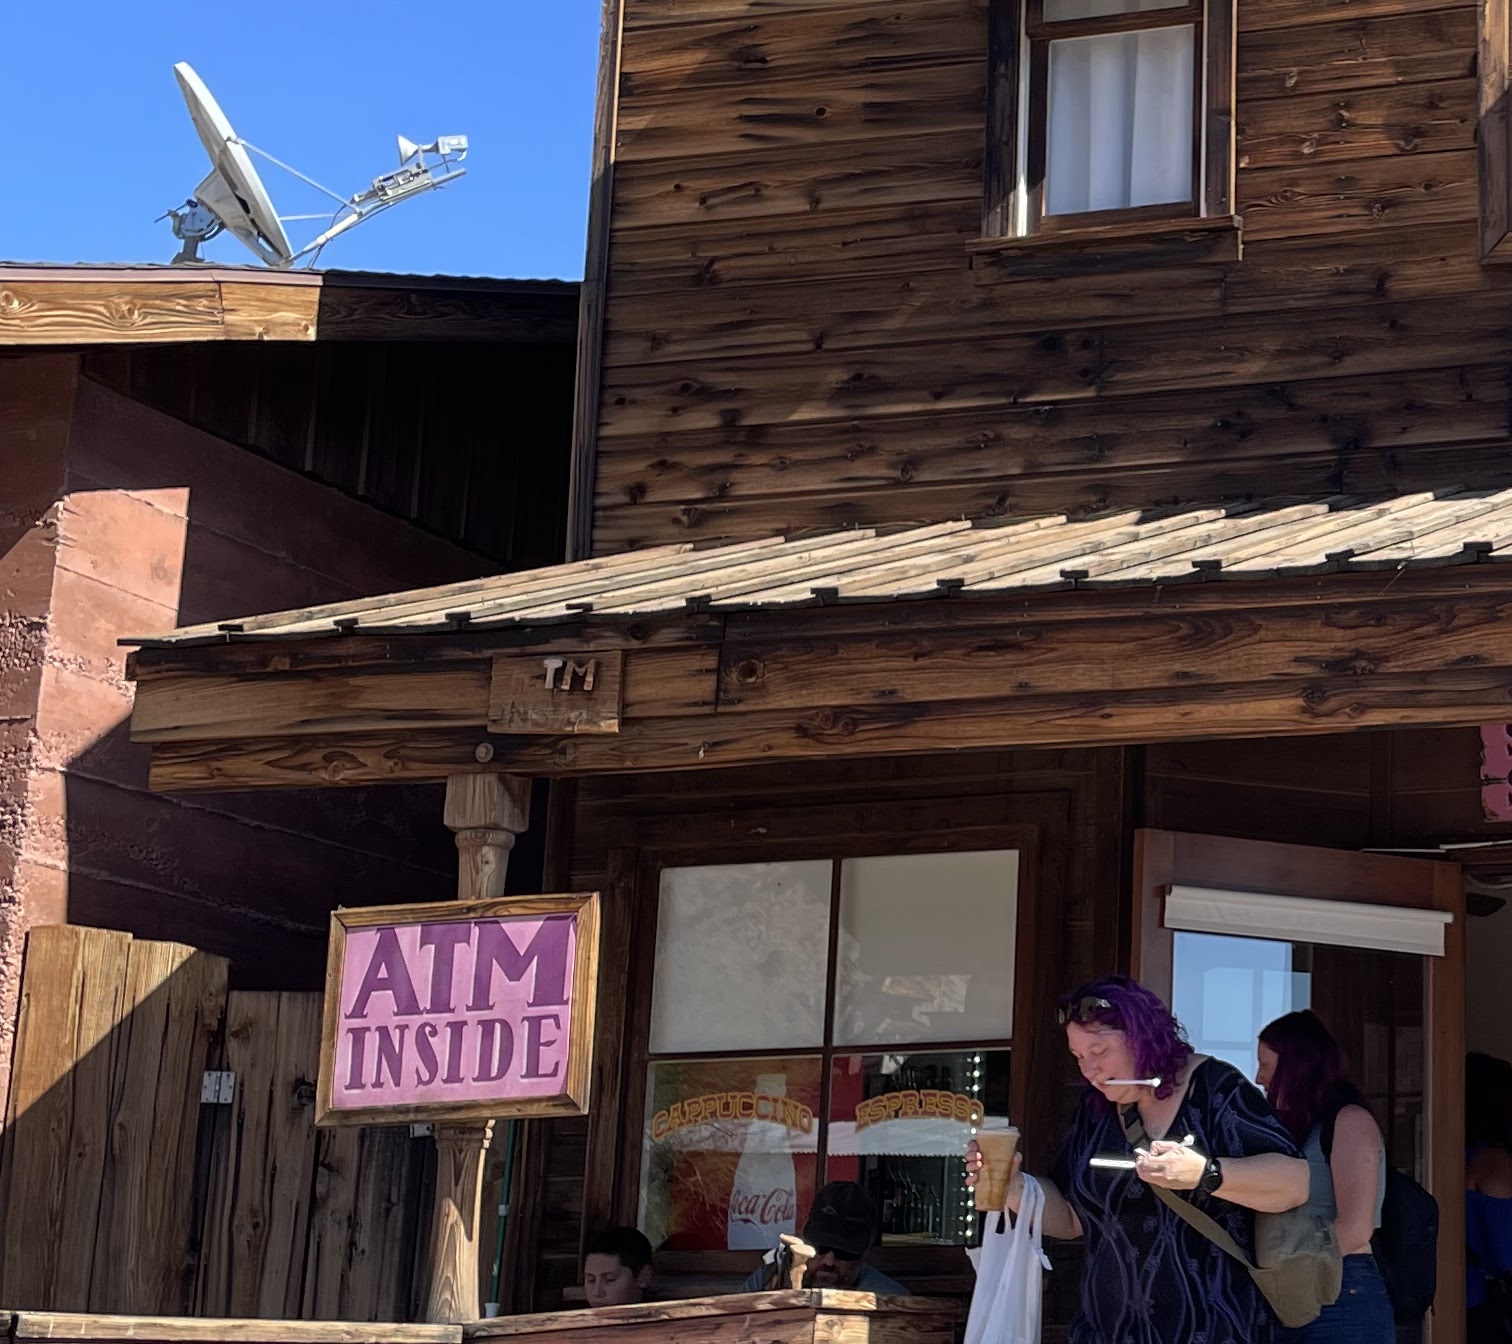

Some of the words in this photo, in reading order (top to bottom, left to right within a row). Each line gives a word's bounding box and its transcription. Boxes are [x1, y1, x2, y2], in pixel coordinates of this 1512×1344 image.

[344, 915, 573, 1019] ATM
[344, 1013, 562, 1090] INSIDE
[652, 1092, 813, 1140] CAPPUCCINO
[855, 1089, 984, 1133] ESPRESSO
